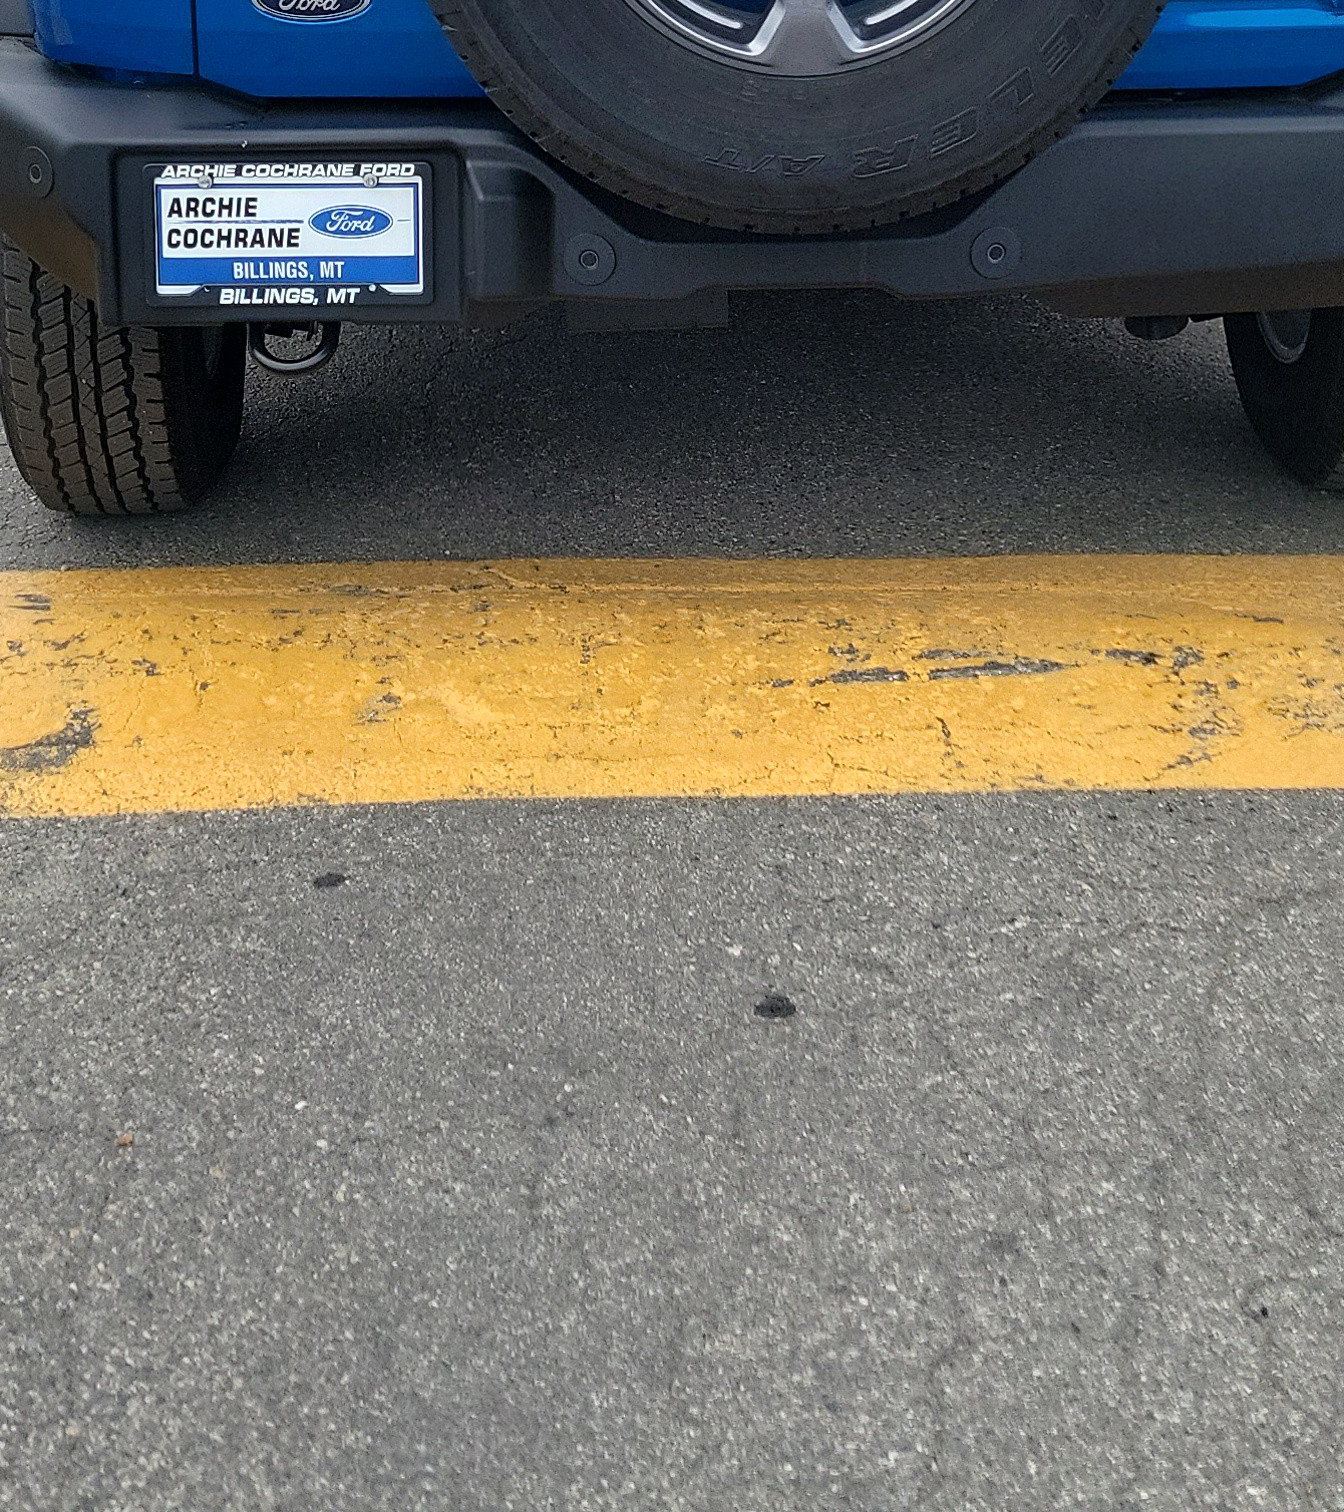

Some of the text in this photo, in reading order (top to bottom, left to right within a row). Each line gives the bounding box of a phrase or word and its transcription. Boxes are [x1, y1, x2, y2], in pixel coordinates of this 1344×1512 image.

[161, 163, 415, 179] ARCHIE COCHRANE FORD
[167, 196, 258, 219] ARCHIE
[325, 210, 376, 232] Ford
[167, 227, 301, 249] COCHRANE
[232, 261, 345, 281] BILLINGS, MT
[219, 287, 360, 305] BILLINGS, MT
